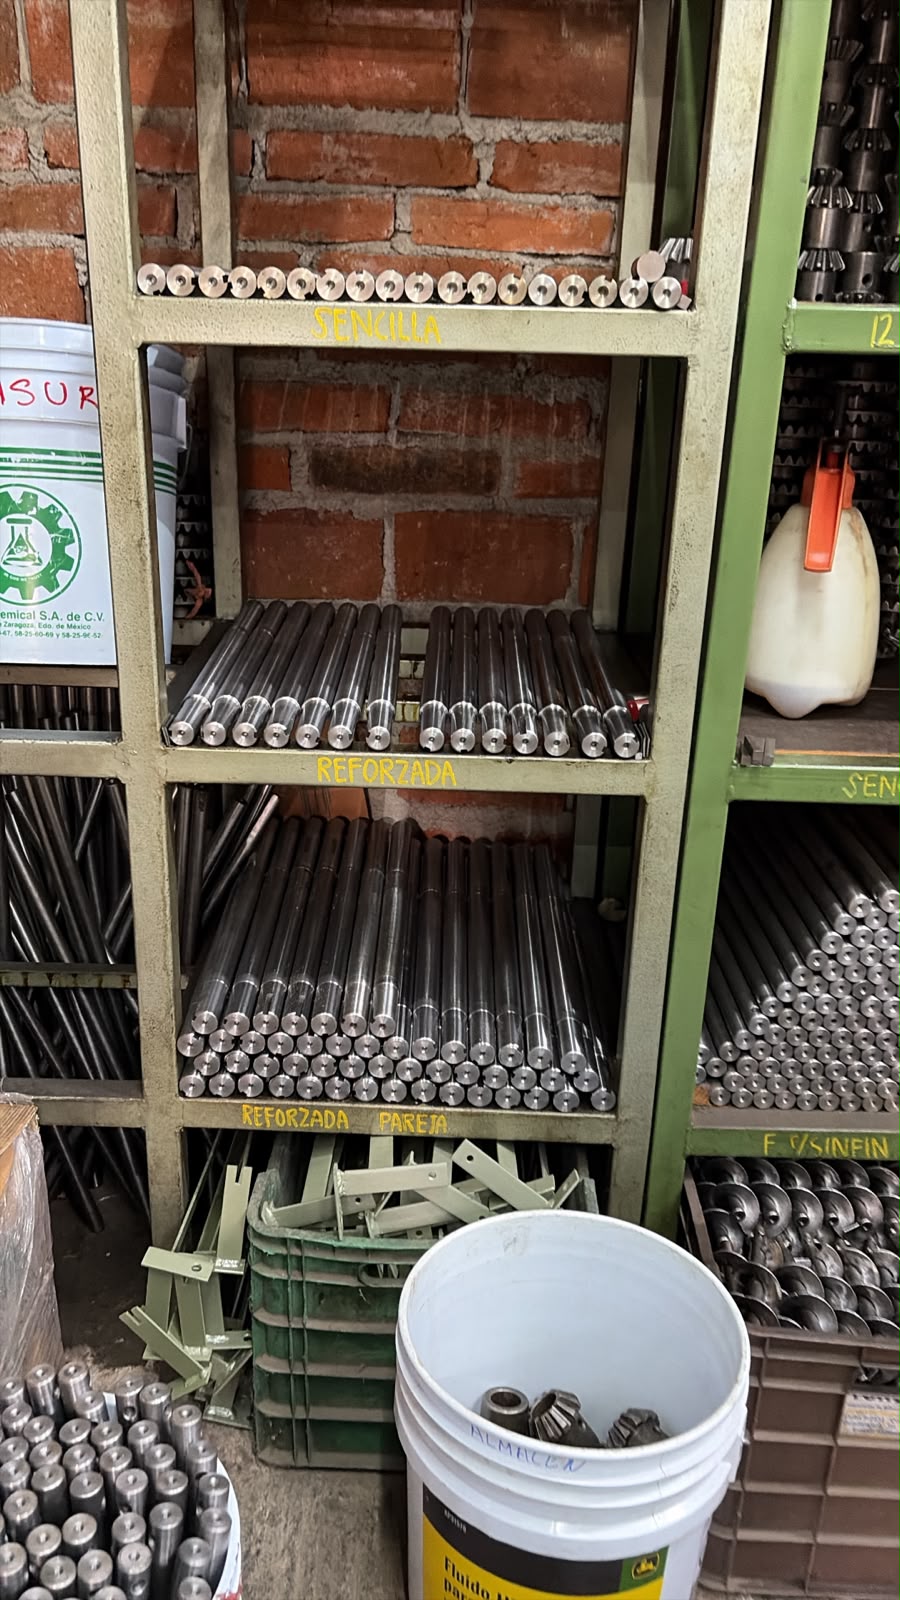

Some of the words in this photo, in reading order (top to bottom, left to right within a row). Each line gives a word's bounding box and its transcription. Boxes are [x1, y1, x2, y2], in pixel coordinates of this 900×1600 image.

[311, 306, 442, 344] SENCILLA
[40, 610, 63, 621] S.A.
[66, 612, 81, 622] de
[84, 612, 105, 622] C.V.
[317, 756, 457, 786] REFORZADA
[242, 1103, 350, 1129] REFORZADA
[379, 1111, 448, 1135] PAREJA
[763, 1133, 777, 1156] F
[444, 1556, 490, 1600] Fluido
